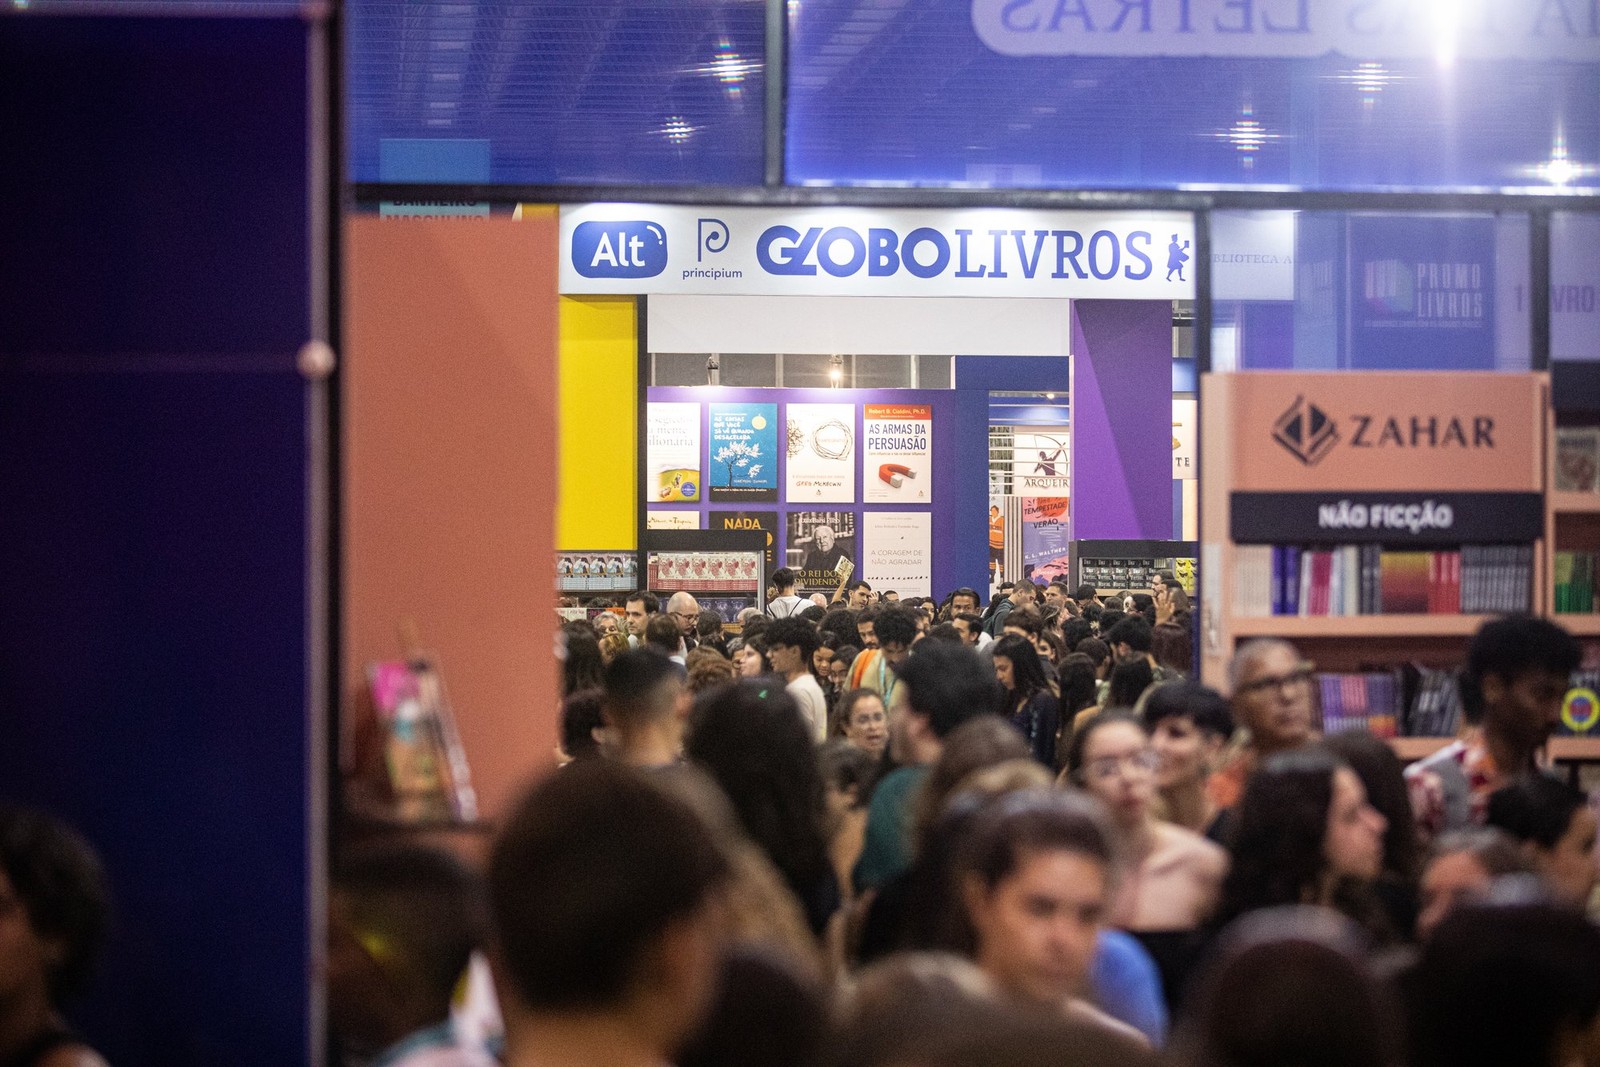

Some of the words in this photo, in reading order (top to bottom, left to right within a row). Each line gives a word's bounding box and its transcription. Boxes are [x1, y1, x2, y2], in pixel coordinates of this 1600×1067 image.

[590, 232, 646, 267] Alt
[756, 225, 951, 278] GLOBO
[954, 229, 1153, 280] LIVROS
[682, 268, 743, 280] principium
[1416, 262, 1482, 289] PROMO
[1417, 292, 1483, 318] LIVROS
[869, 424, 880, 434] AS
[882, 424, 913, 434] ARMAS
[914, 424, 926, 434] DA
[1350, 415, 1496, 448] ZAHAR
[868, 435, 927, 450] PERSUASÃO
[1175, 457, 1190, 467] TE
[1024, 501, 1066, 515] TEMPESTADE
[724, 518, 761, 530] NADA
[1318, 501, 1368, 528] NÃO
[1370, 501, 1454, 534] FICÇÃO
[871, 557, 887, 565] NÃO
